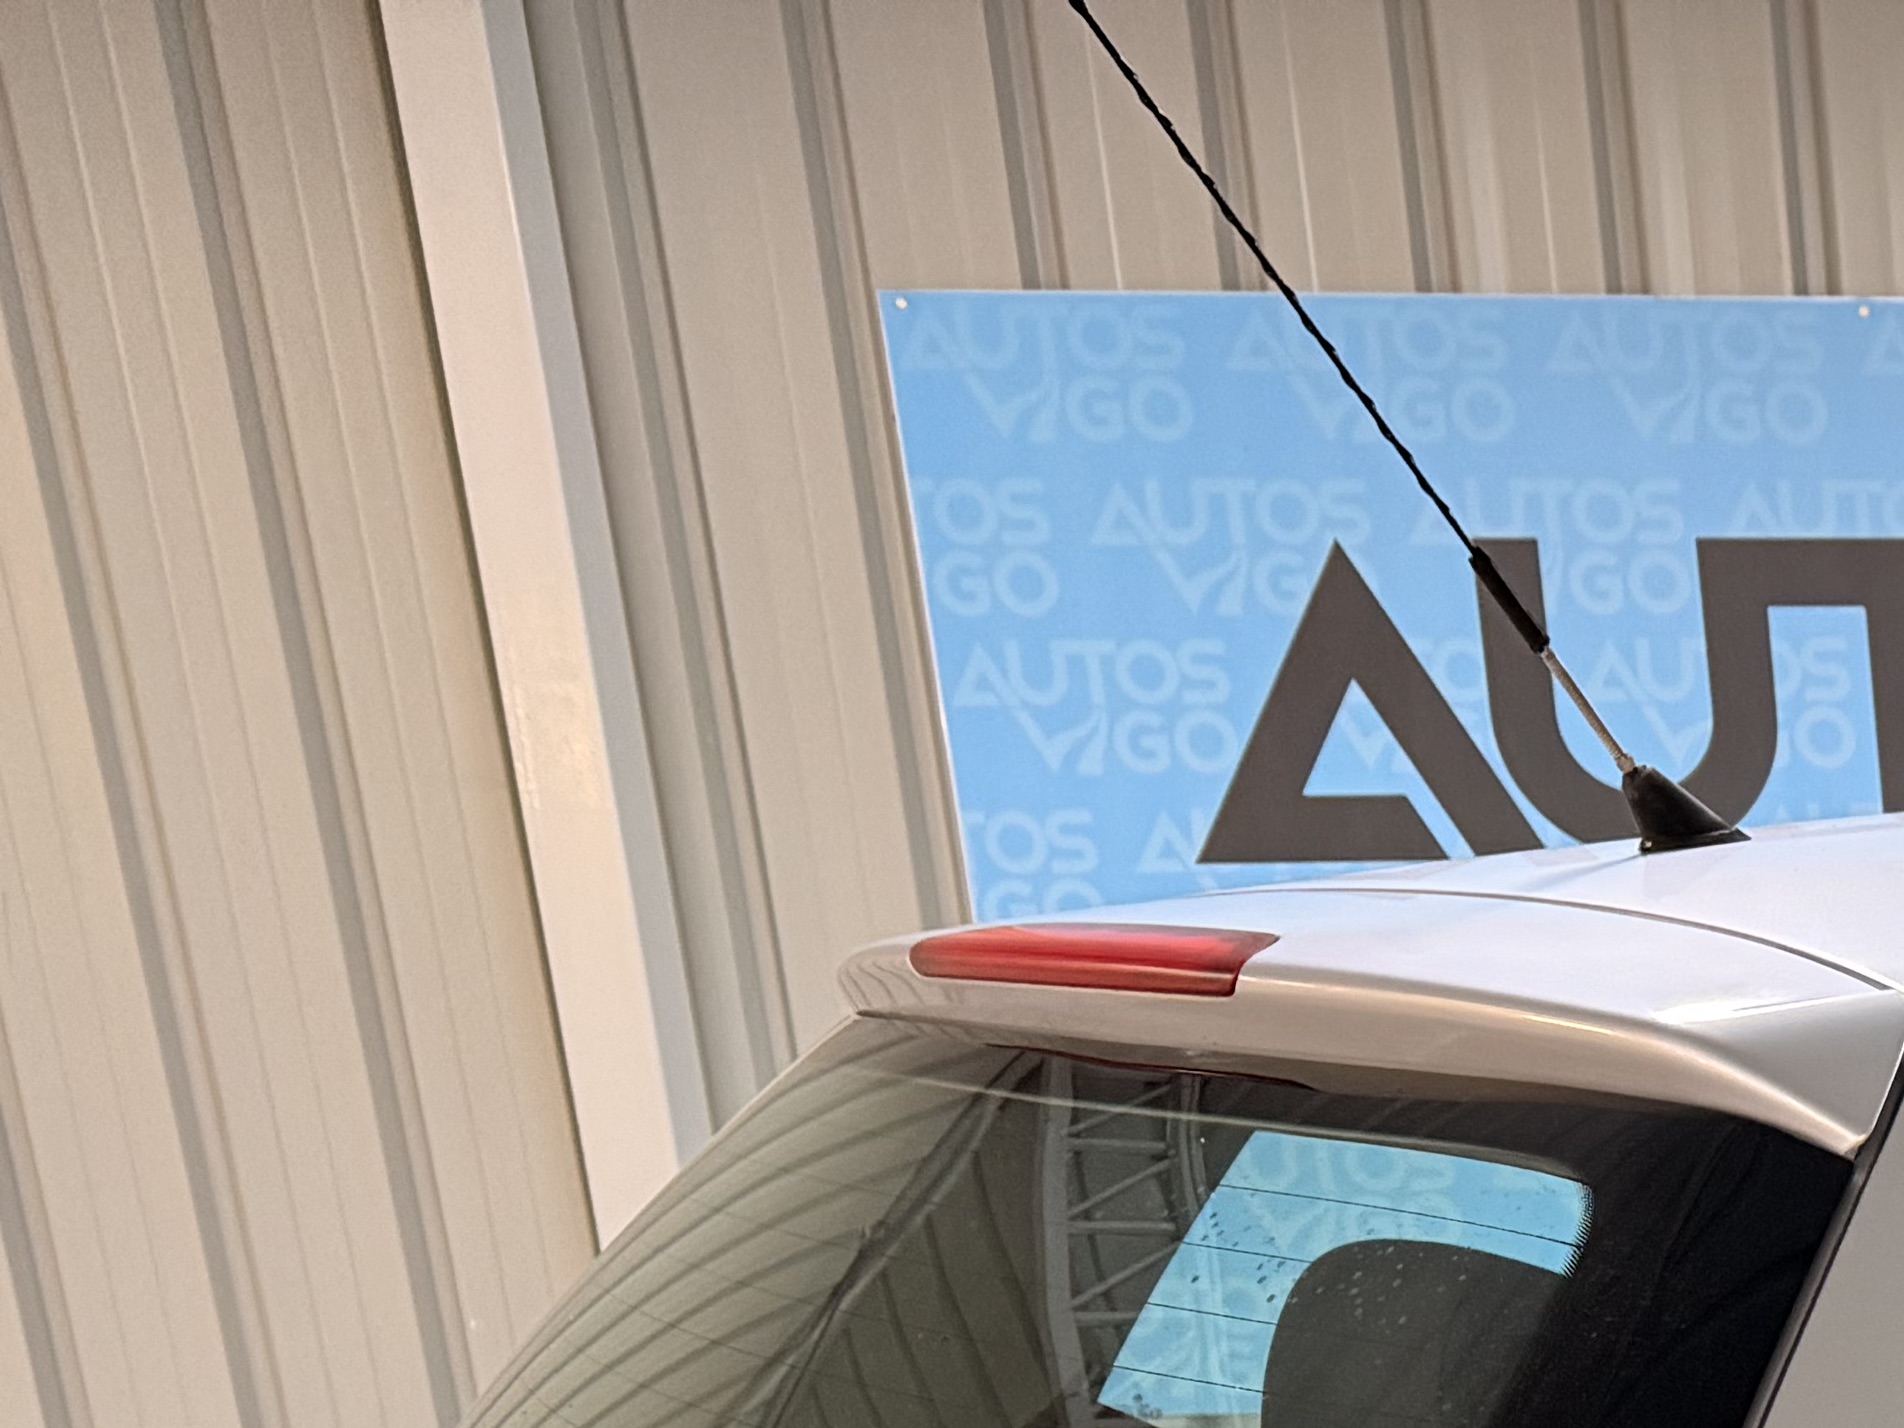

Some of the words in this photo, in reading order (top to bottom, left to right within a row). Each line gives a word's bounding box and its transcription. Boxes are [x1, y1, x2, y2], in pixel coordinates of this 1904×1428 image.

[904, 305, 1184, 368] AUTOS
[1229, 307, 1504, 369] AUTOS
[1547, 308, 1822, 373] AUTOS
[1093, 480, 1369, 544] AUTOS
[956, 639, 1229, 706] AUTOS
[1012, 710, 1236, 774] VIGO
